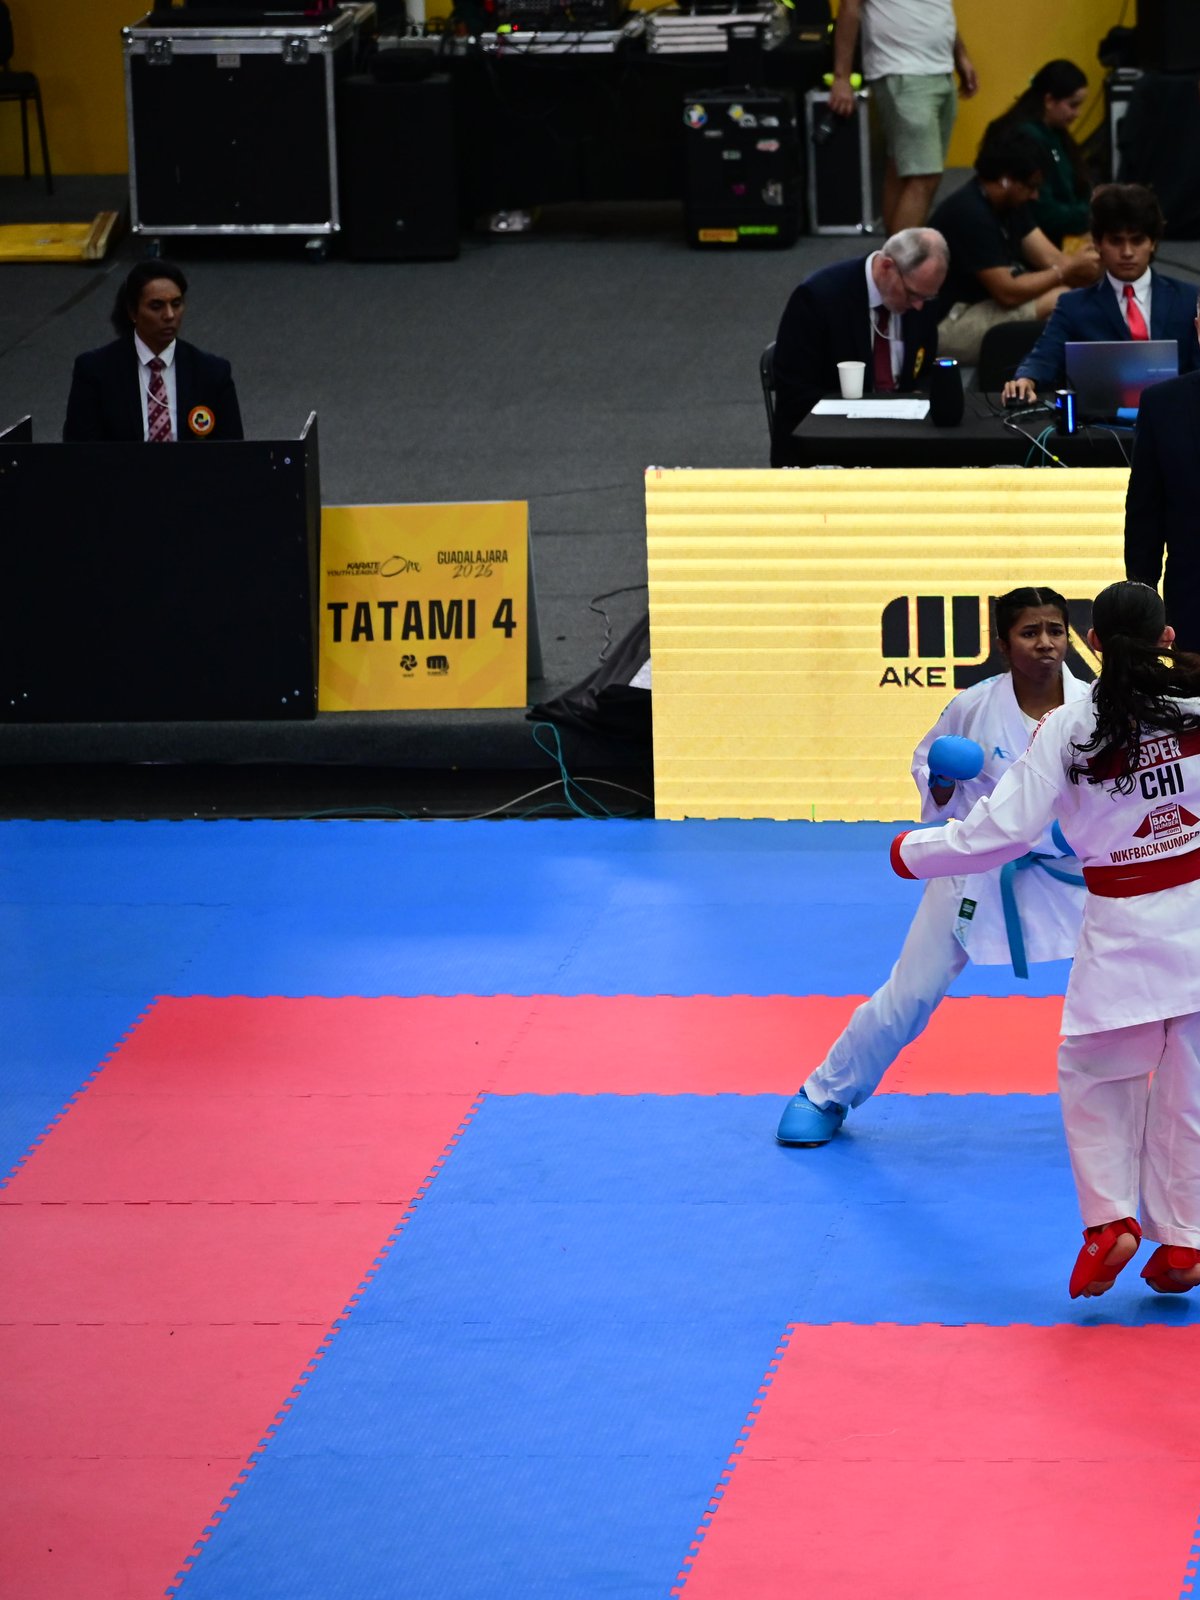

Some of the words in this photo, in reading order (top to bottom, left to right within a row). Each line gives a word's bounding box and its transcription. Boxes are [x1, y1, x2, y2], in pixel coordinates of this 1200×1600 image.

[437, 550, 508, 564] GUADALAJARA
[347, 562, 381, 570] KARATE
[452, 564, 493, 579] 2026
[327, 599, 476, 643] TATAMI
[492, 598, 517, 639] 4
[1129, 736, 1182, 769] SPER
[1140, 763, 1185, 800] CHI
[1152, 811, 1178, 826] BACK
[1154, 820, 1179, 831] NUMBER
